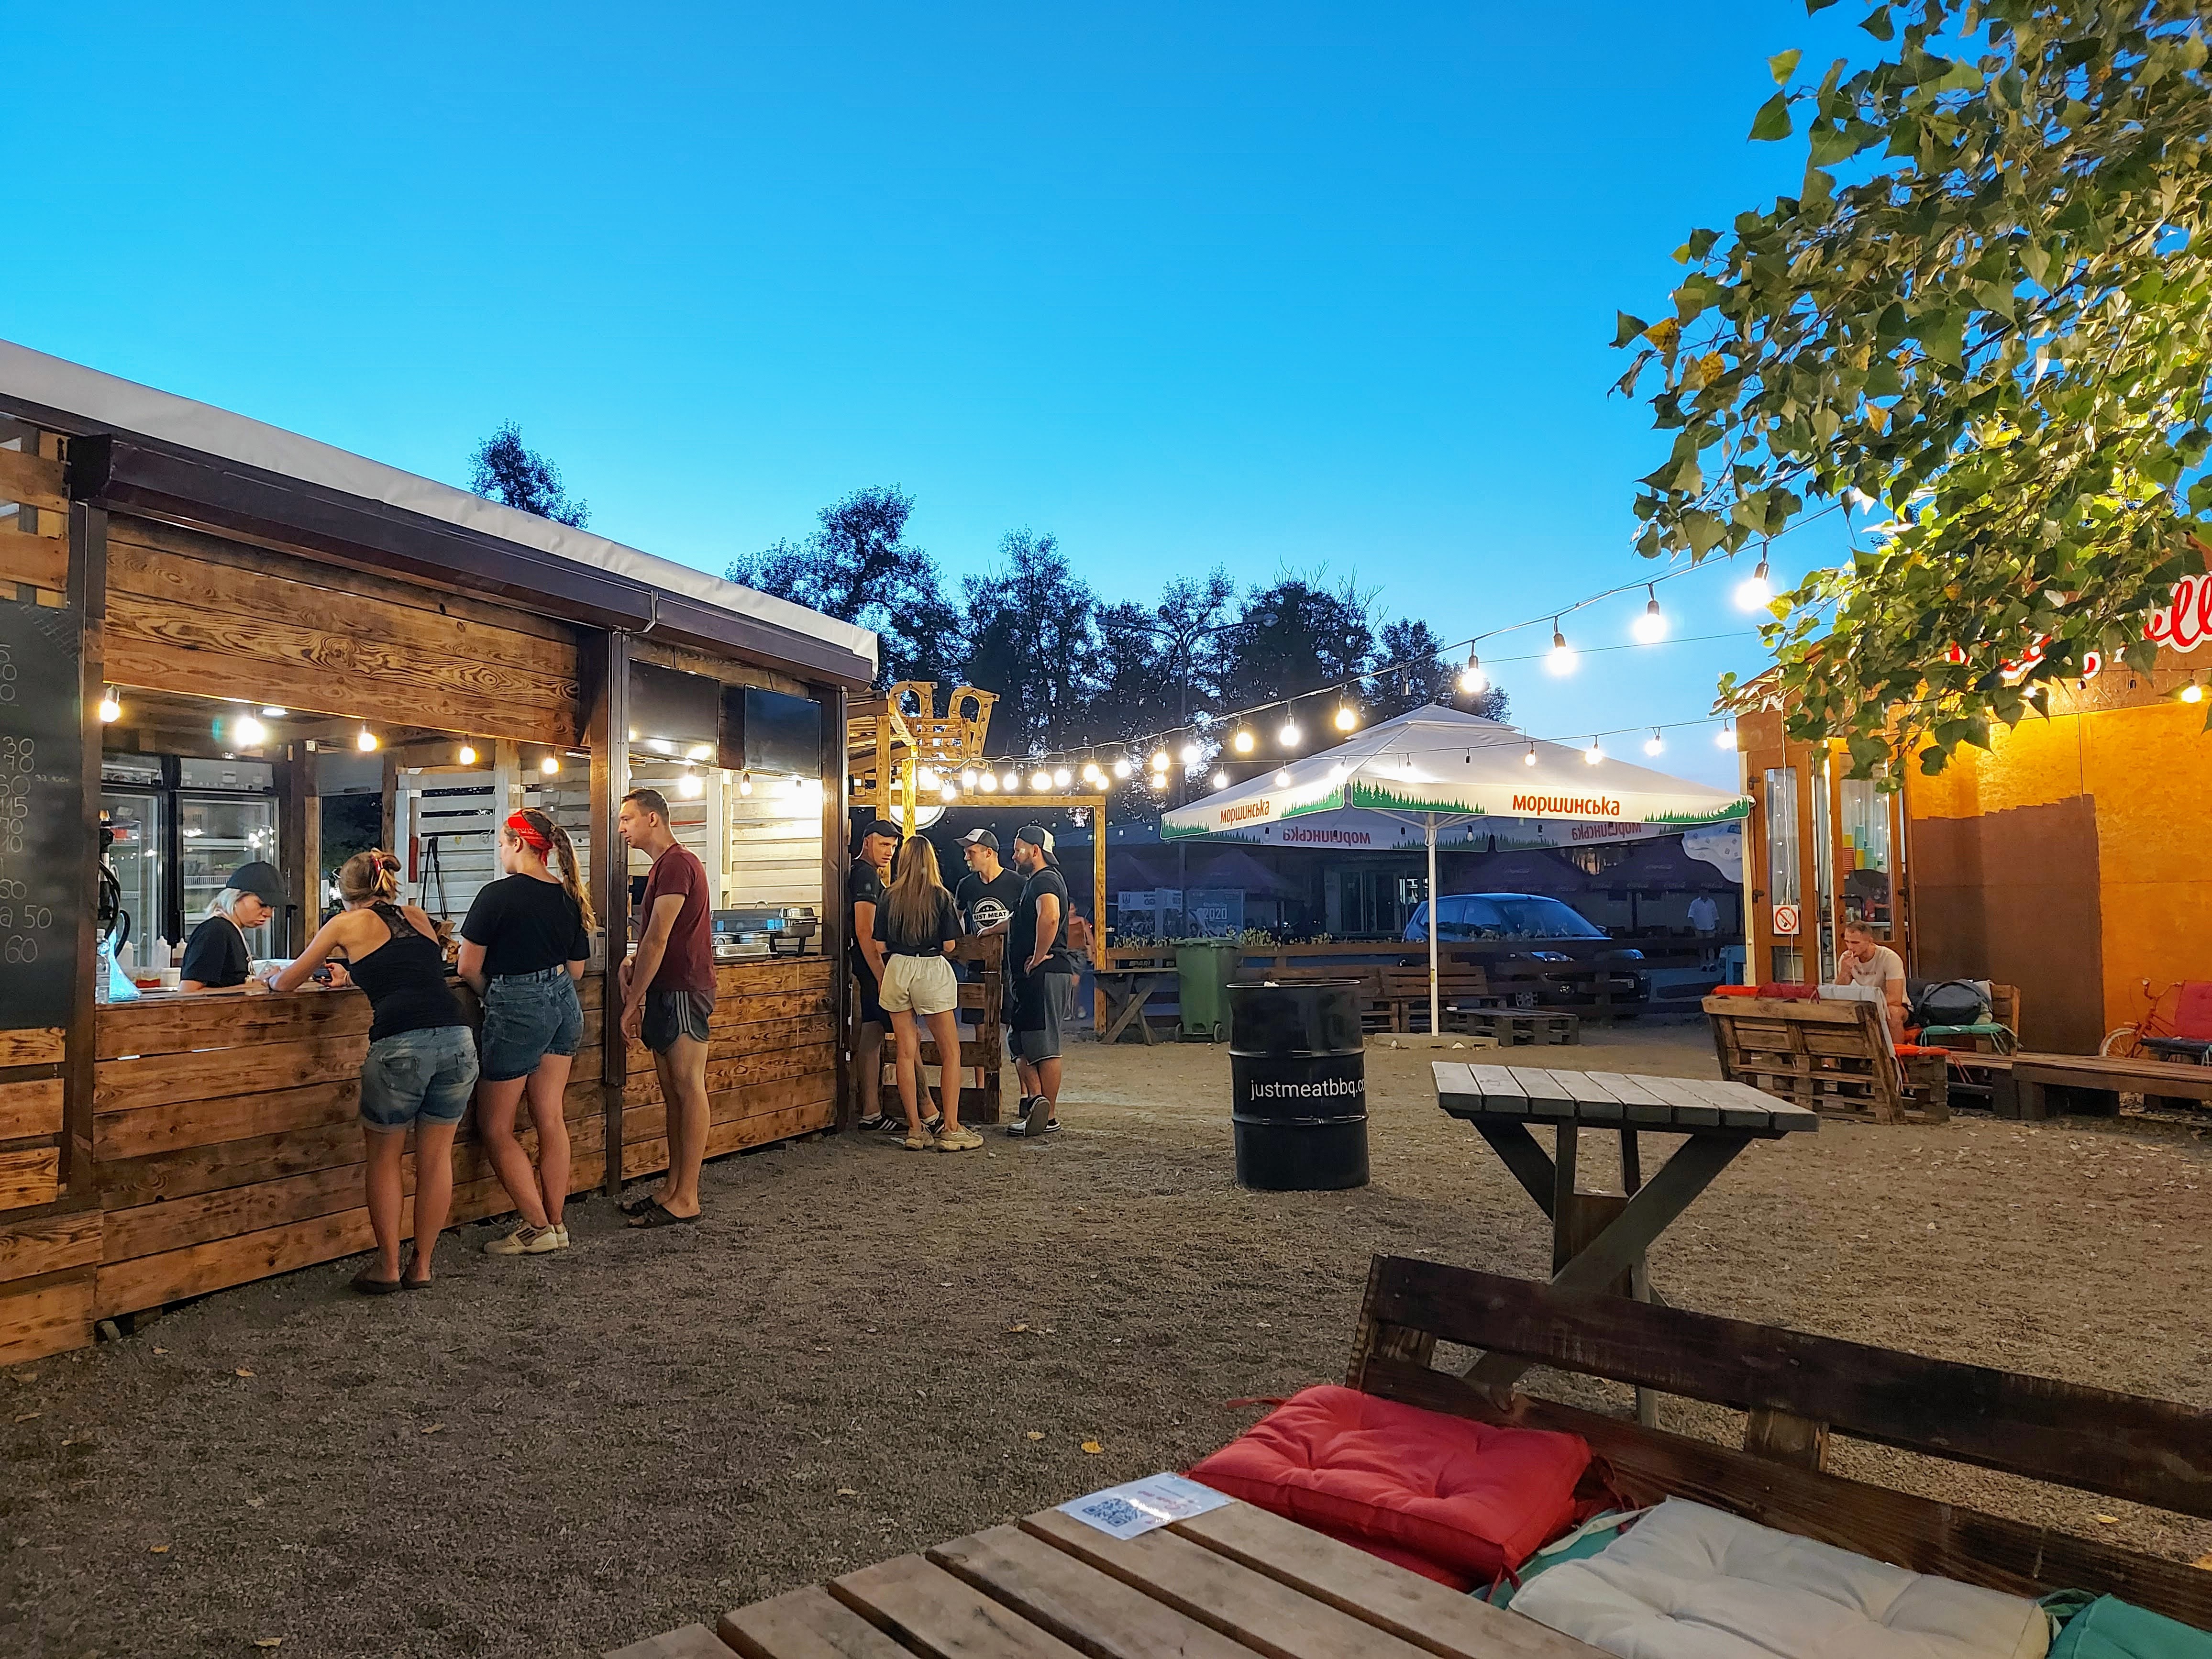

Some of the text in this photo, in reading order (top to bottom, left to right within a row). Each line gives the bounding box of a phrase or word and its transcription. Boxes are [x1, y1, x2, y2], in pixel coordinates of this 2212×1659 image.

[3, 736, 34, 756] 30
[1220, 798, 1270, 826] моршинська
[1512, 794, 1620, 816] моршинська
[23, 905, 52, 929] 50
[5, 935, 38, 963] 60
